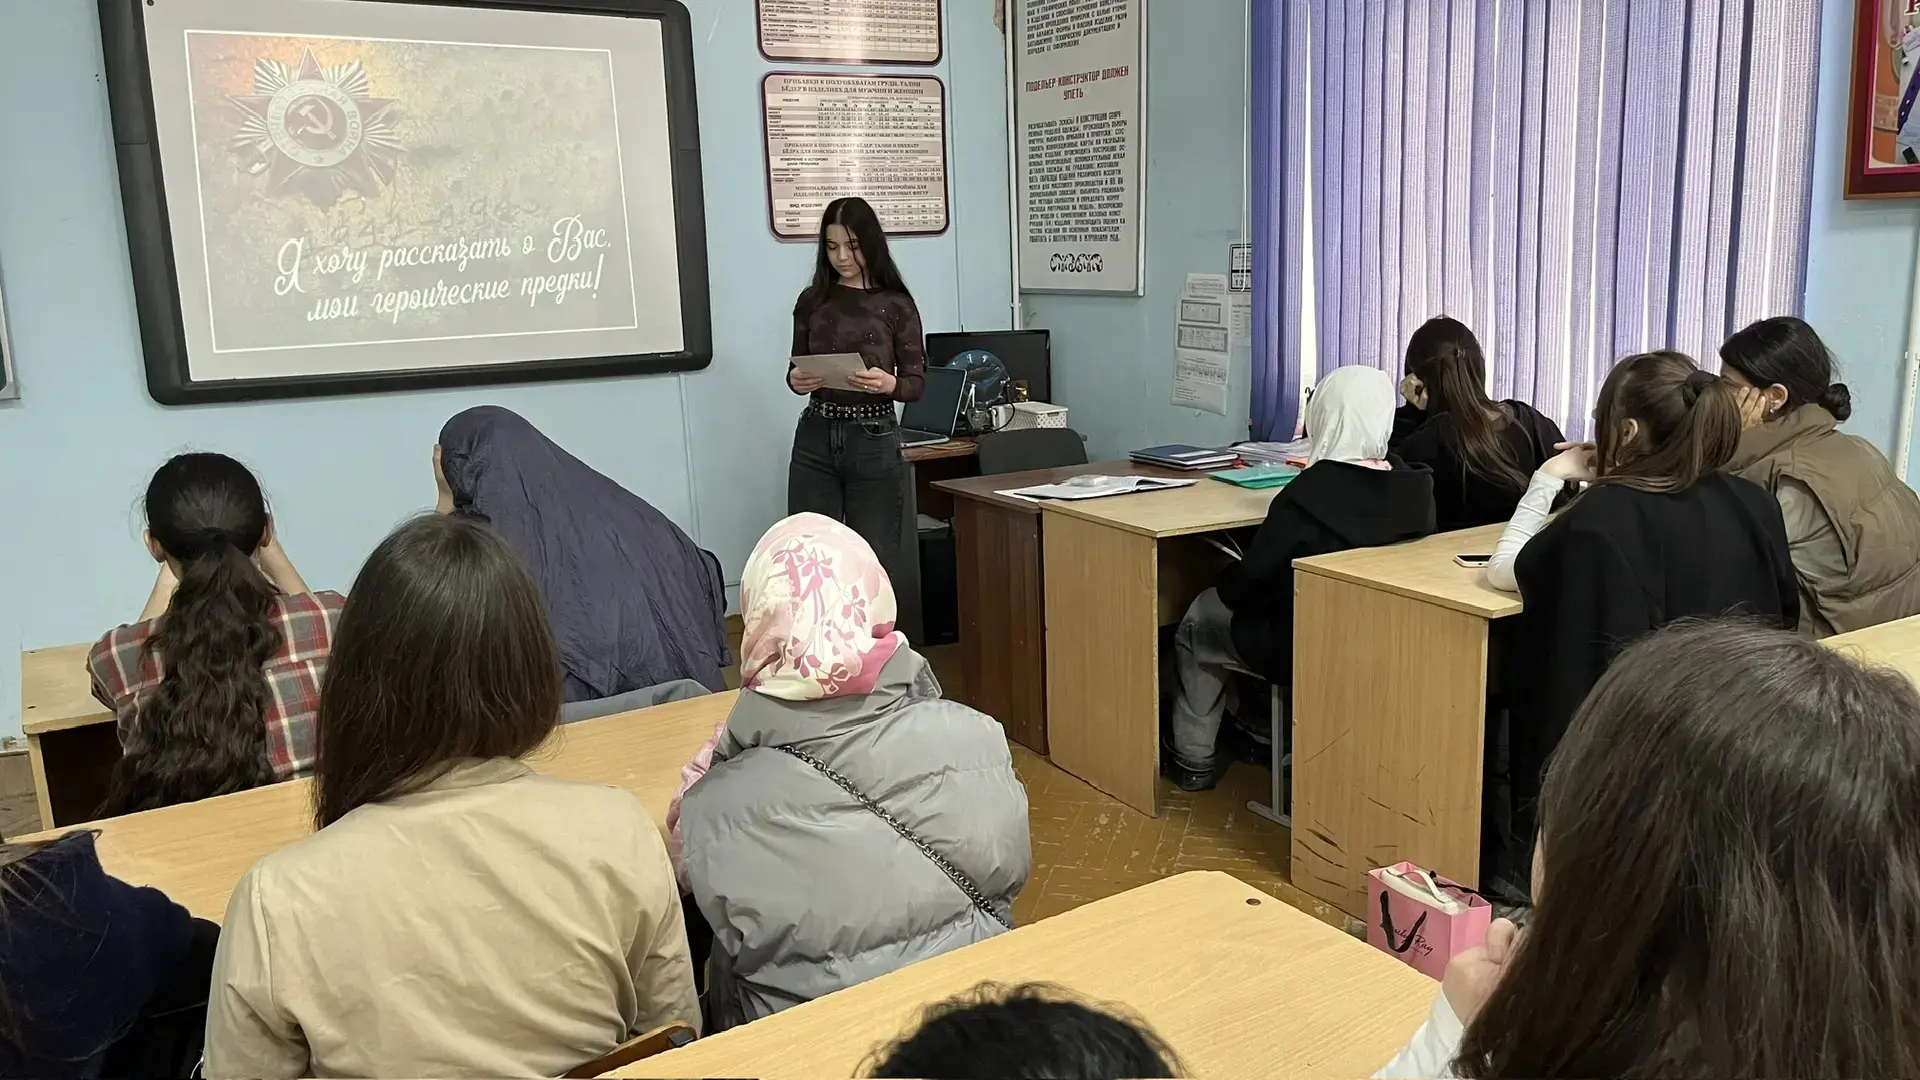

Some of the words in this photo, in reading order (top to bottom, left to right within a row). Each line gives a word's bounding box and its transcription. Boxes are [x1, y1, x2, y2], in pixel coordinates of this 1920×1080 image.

[1102, 66, 1129, 80] ДОЛЖЕН
[274, 238, 306, 295] Я
[312, 254, 369, 284] хочу
[377, 235, 512, 281] рассказать
[521, 235, 536, 255] о
[307, 294, 359, 321] мои
[370, 276, 511, 324] героические
[520, 253, 604, 308] предки!
[1414, 935, 1434, 956] Ray
